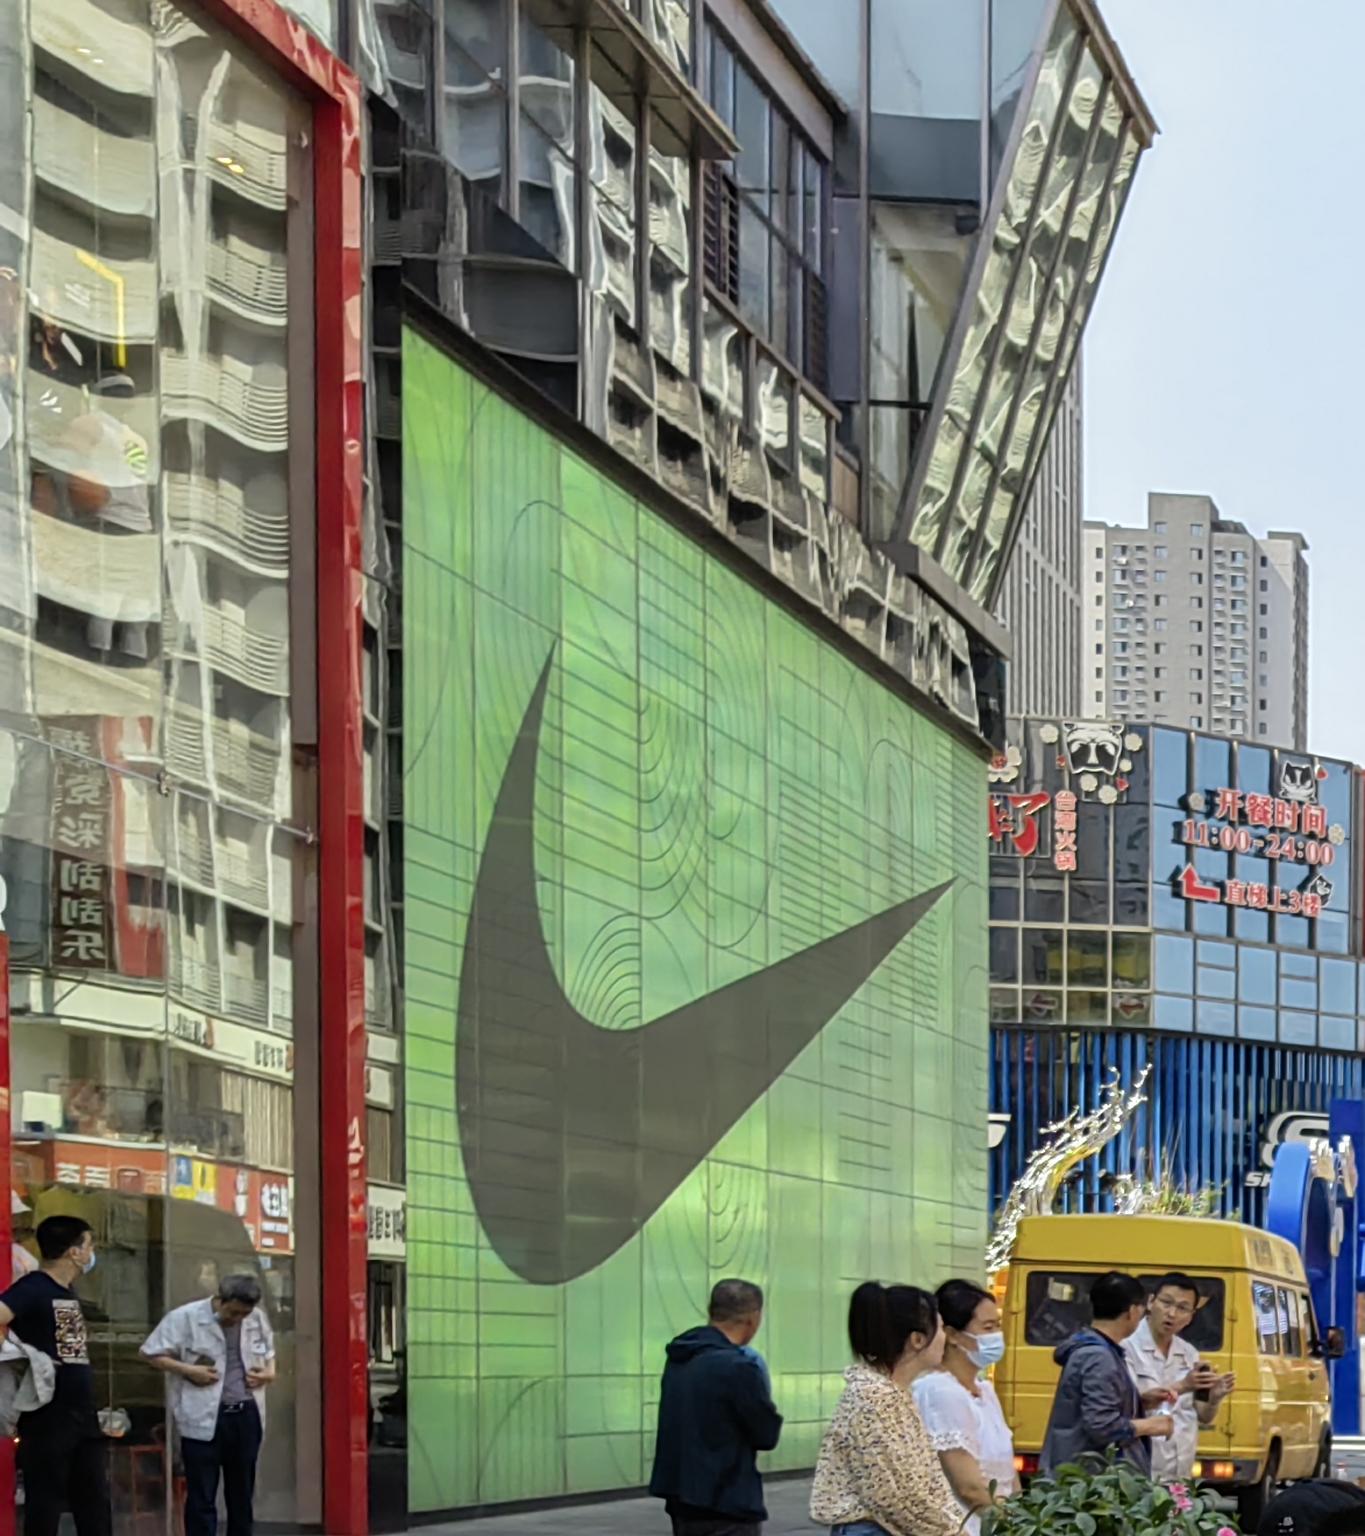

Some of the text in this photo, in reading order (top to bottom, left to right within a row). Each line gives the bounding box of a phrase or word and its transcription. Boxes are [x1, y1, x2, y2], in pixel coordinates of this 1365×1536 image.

[1215, 788, 1328, 838] 开餐时间
[1183, 819, 1336, 867] 11:00-24:00
